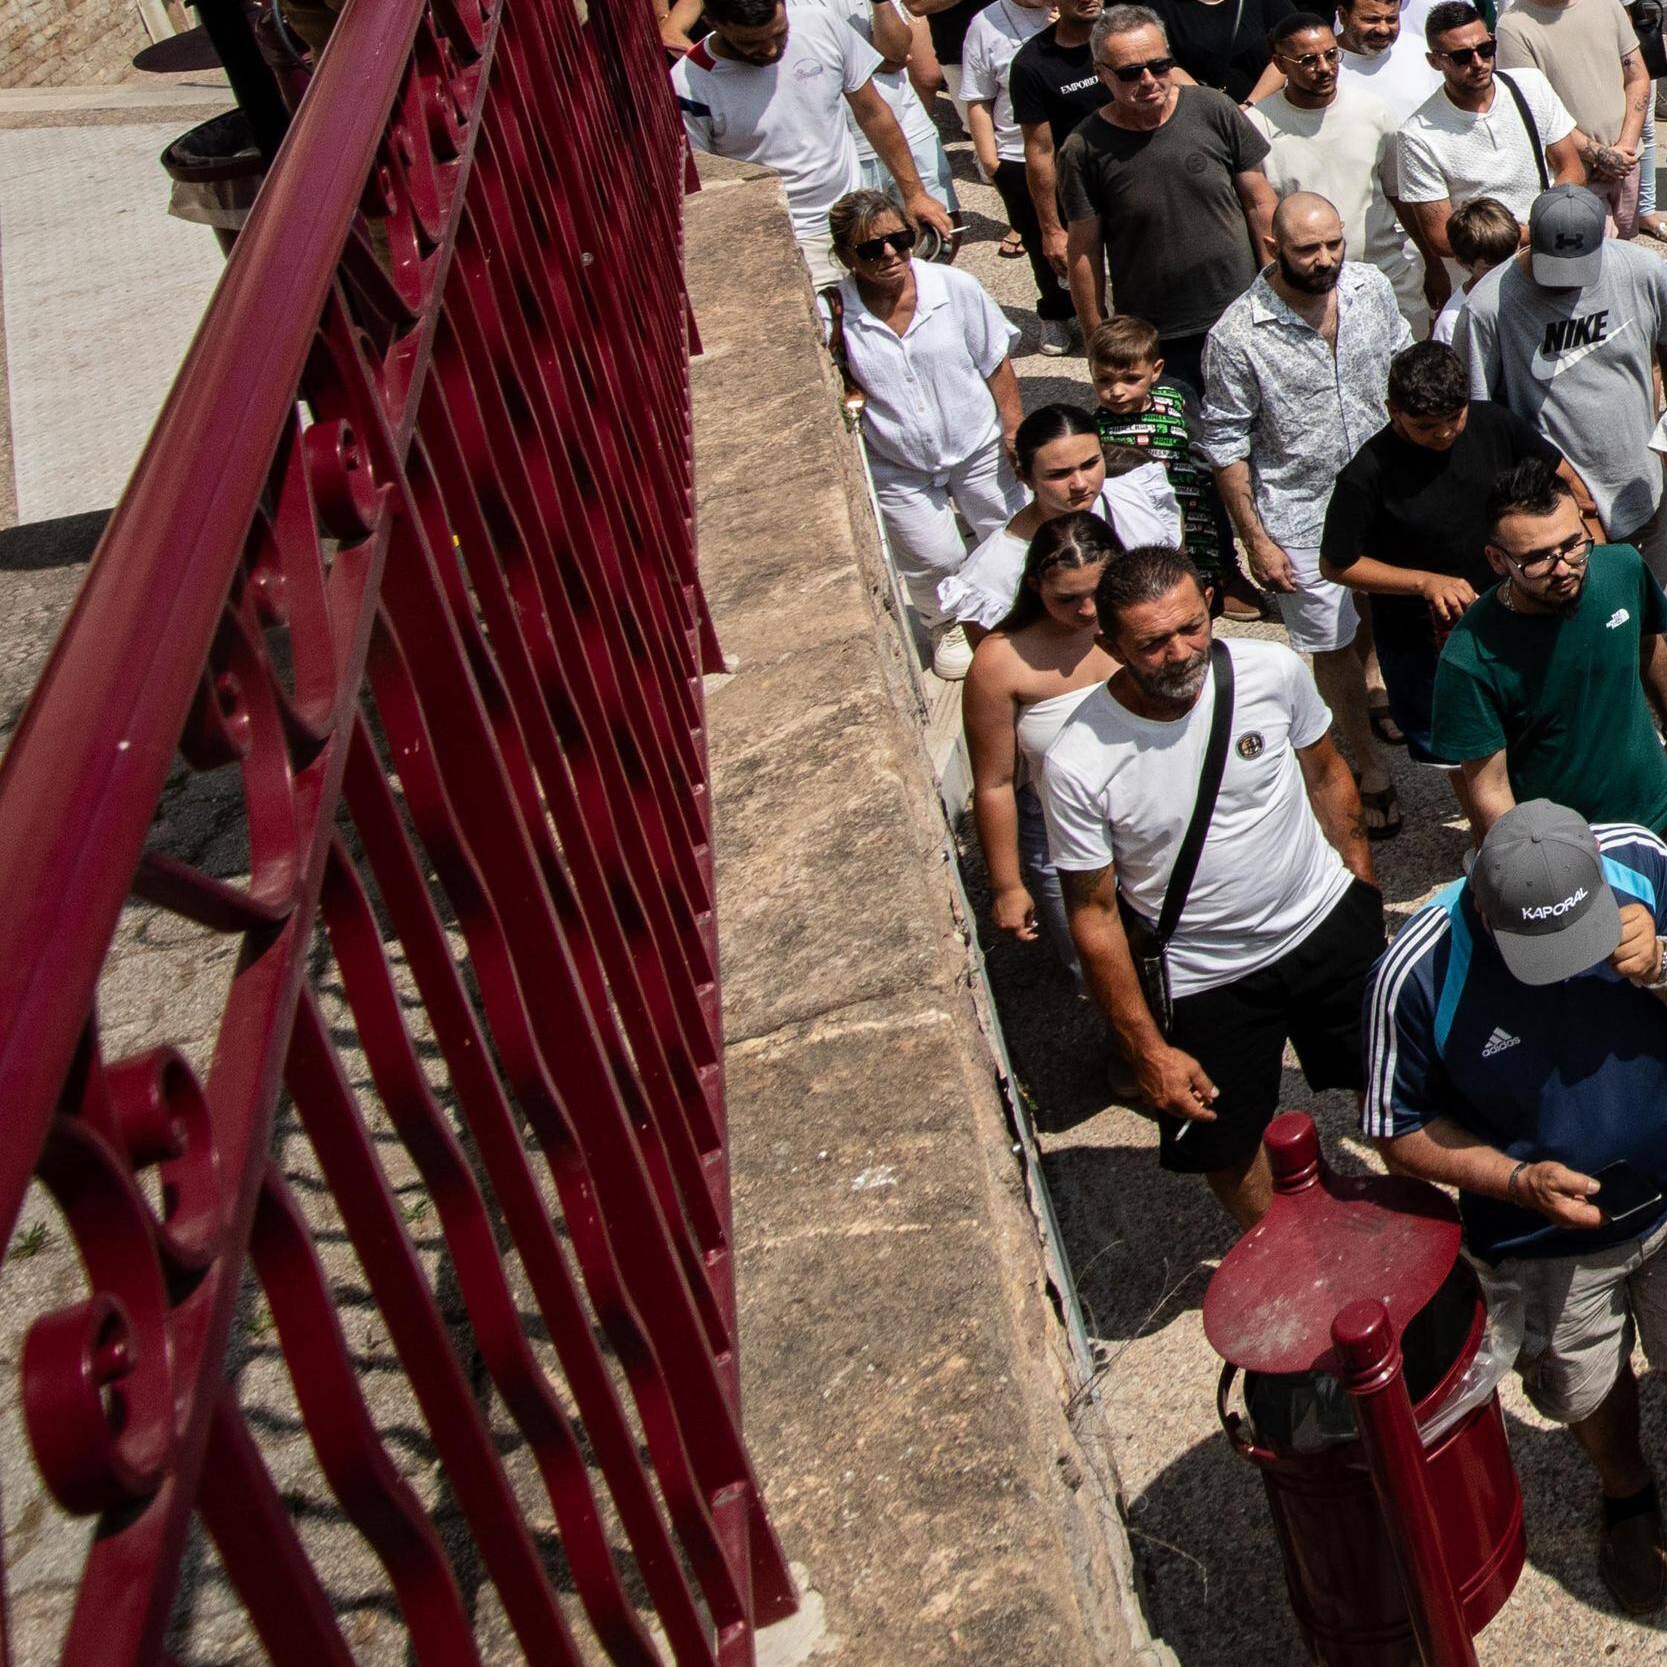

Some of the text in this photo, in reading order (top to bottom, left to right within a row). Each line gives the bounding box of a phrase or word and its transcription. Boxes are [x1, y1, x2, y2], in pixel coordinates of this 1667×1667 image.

[1060, 75, 1097, 94] EMPORIO
[1542, 310, 1610, 354] NIKE
[1521, 887, 1589, 920] KAPORAL
[1482, 1036, 1521, 1057] adidas
